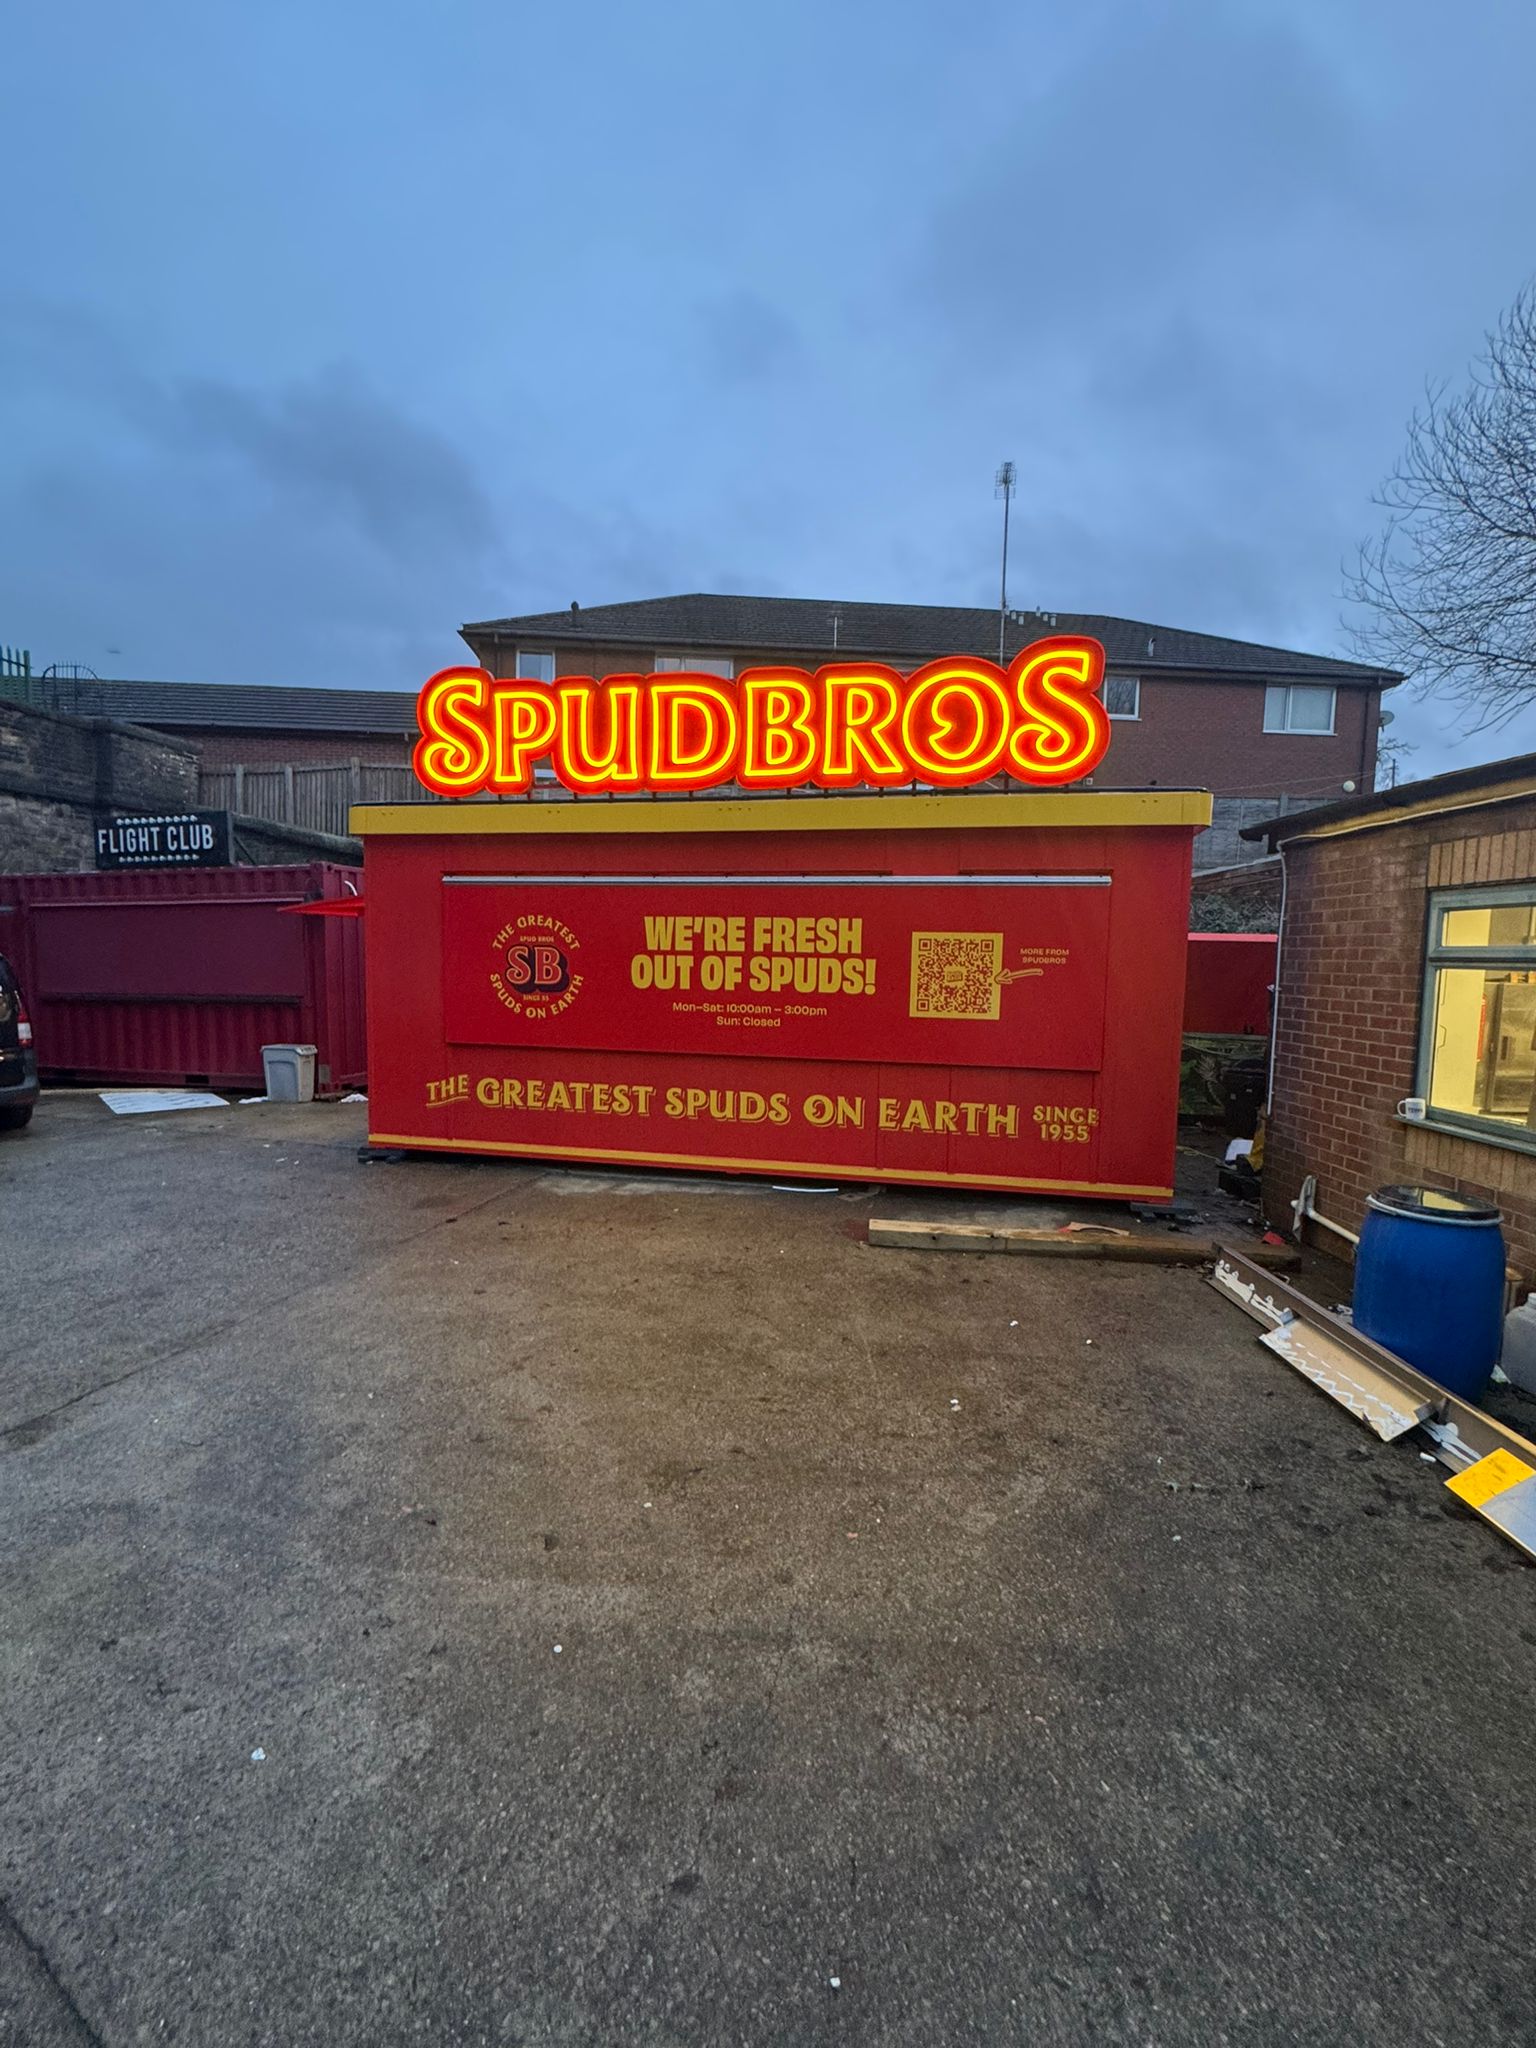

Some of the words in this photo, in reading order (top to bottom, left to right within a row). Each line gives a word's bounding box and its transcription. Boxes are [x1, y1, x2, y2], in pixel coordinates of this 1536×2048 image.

[415, 638, 1108, 796] SPUDBROS
[98, 826, 160, 854] FLIGHT
[167, 824, 214, 851] CLUB
[492, 923, 515, 950] THE
[516, 914, 581, 950] GREATEST
[644, 916, 746, 952] WE'RE
[753, 917, 863, 954] FRESH
[506, 945, 567, 990] SB
[1022, 956, 1066, 964] SPUDBROS
[1045, 948, 1069, 956] FROM
[630, 954, 695, 990] OUT
[701, 955, 743, 991] OF
[749, 957, 877, 996] SPUDS!
[490, 972, 523, 1014] SPUDS
[525, 1006, 547, 1019] ON
[549, 974, 585, 1015] EARTH
[726, 1003, 772, 1015] 10:00am
[784, 1004, 828, 1017] 3:00pm
[716, 1015, 742, 1027] Sun:
[743, 1016, 781, 1028] Closed
[425, 1074, 469, 1102] THE
[476, 1077, 656, 1117] GREATEST
[664, 1087, 791, 1125] SPUDS
[803, 1094, 864, 1128] ON
[877, 1097, 1020, 1138] EARTH
[1032, 1104, 1099, 1126] SINCE
[1039, 1123, 1090, 1143] 1955
